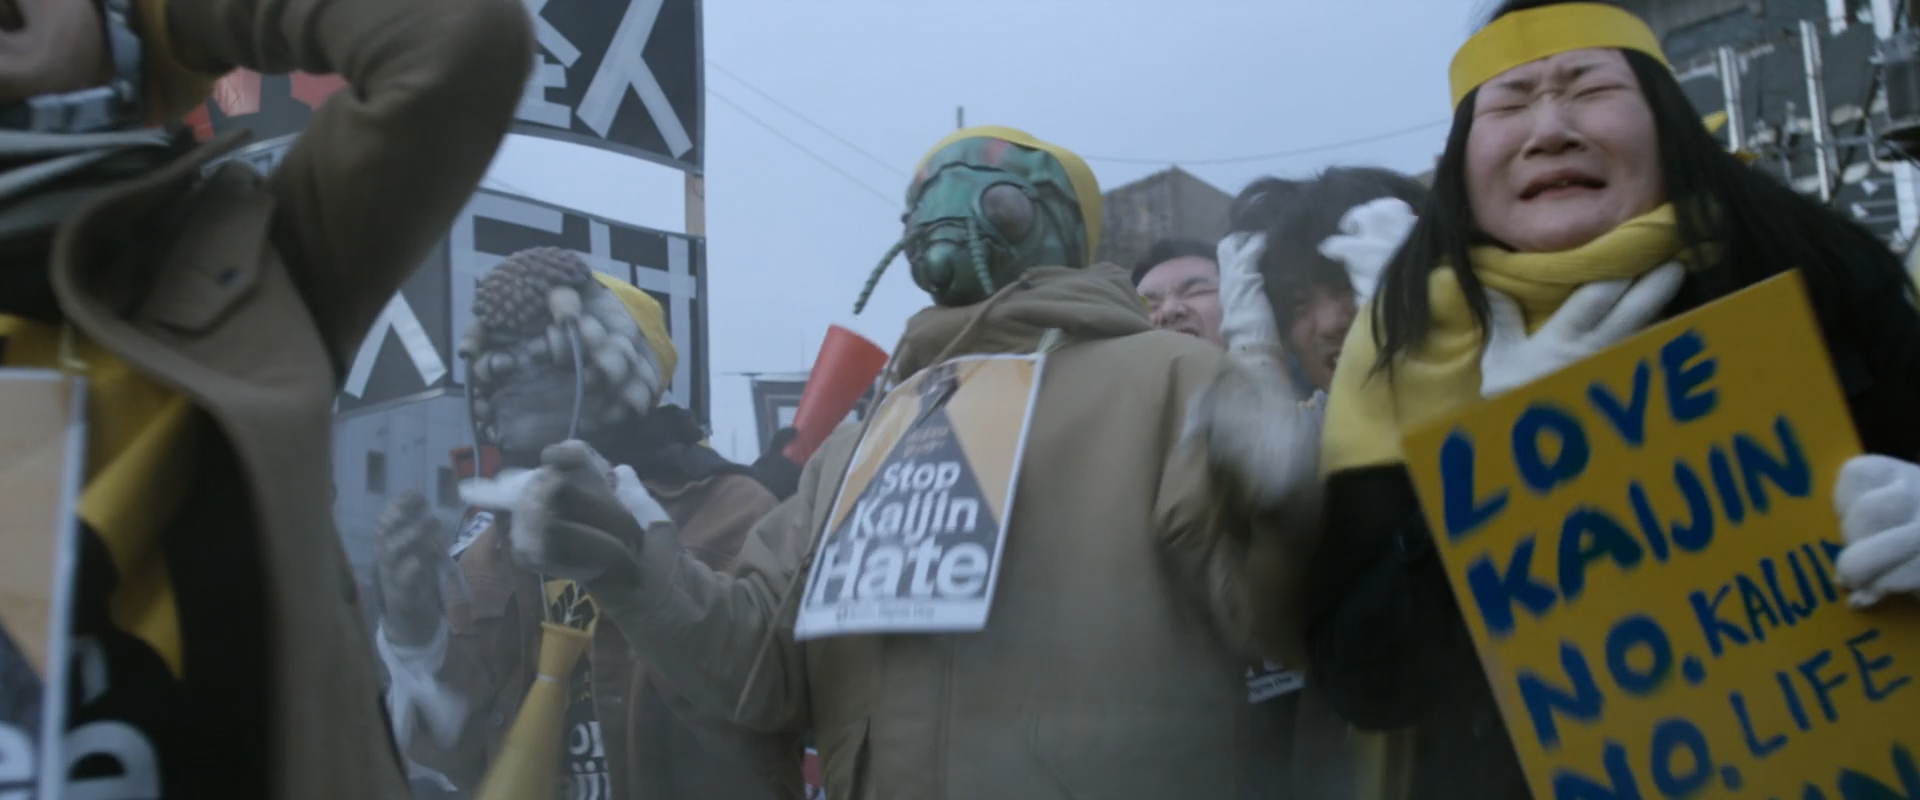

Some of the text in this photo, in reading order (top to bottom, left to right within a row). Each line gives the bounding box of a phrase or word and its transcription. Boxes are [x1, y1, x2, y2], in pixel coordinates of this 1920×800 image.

[880, 460, 962, 496] Stop
[1439, 327, 1718, 541] LOVE
[848, 491, 979, 545] Kaijin
[1466, 415, 1812, 638] KAIJIN
[811, 535, 990, 606] Hate
[1728, 629, 1912, 759] LIFE
